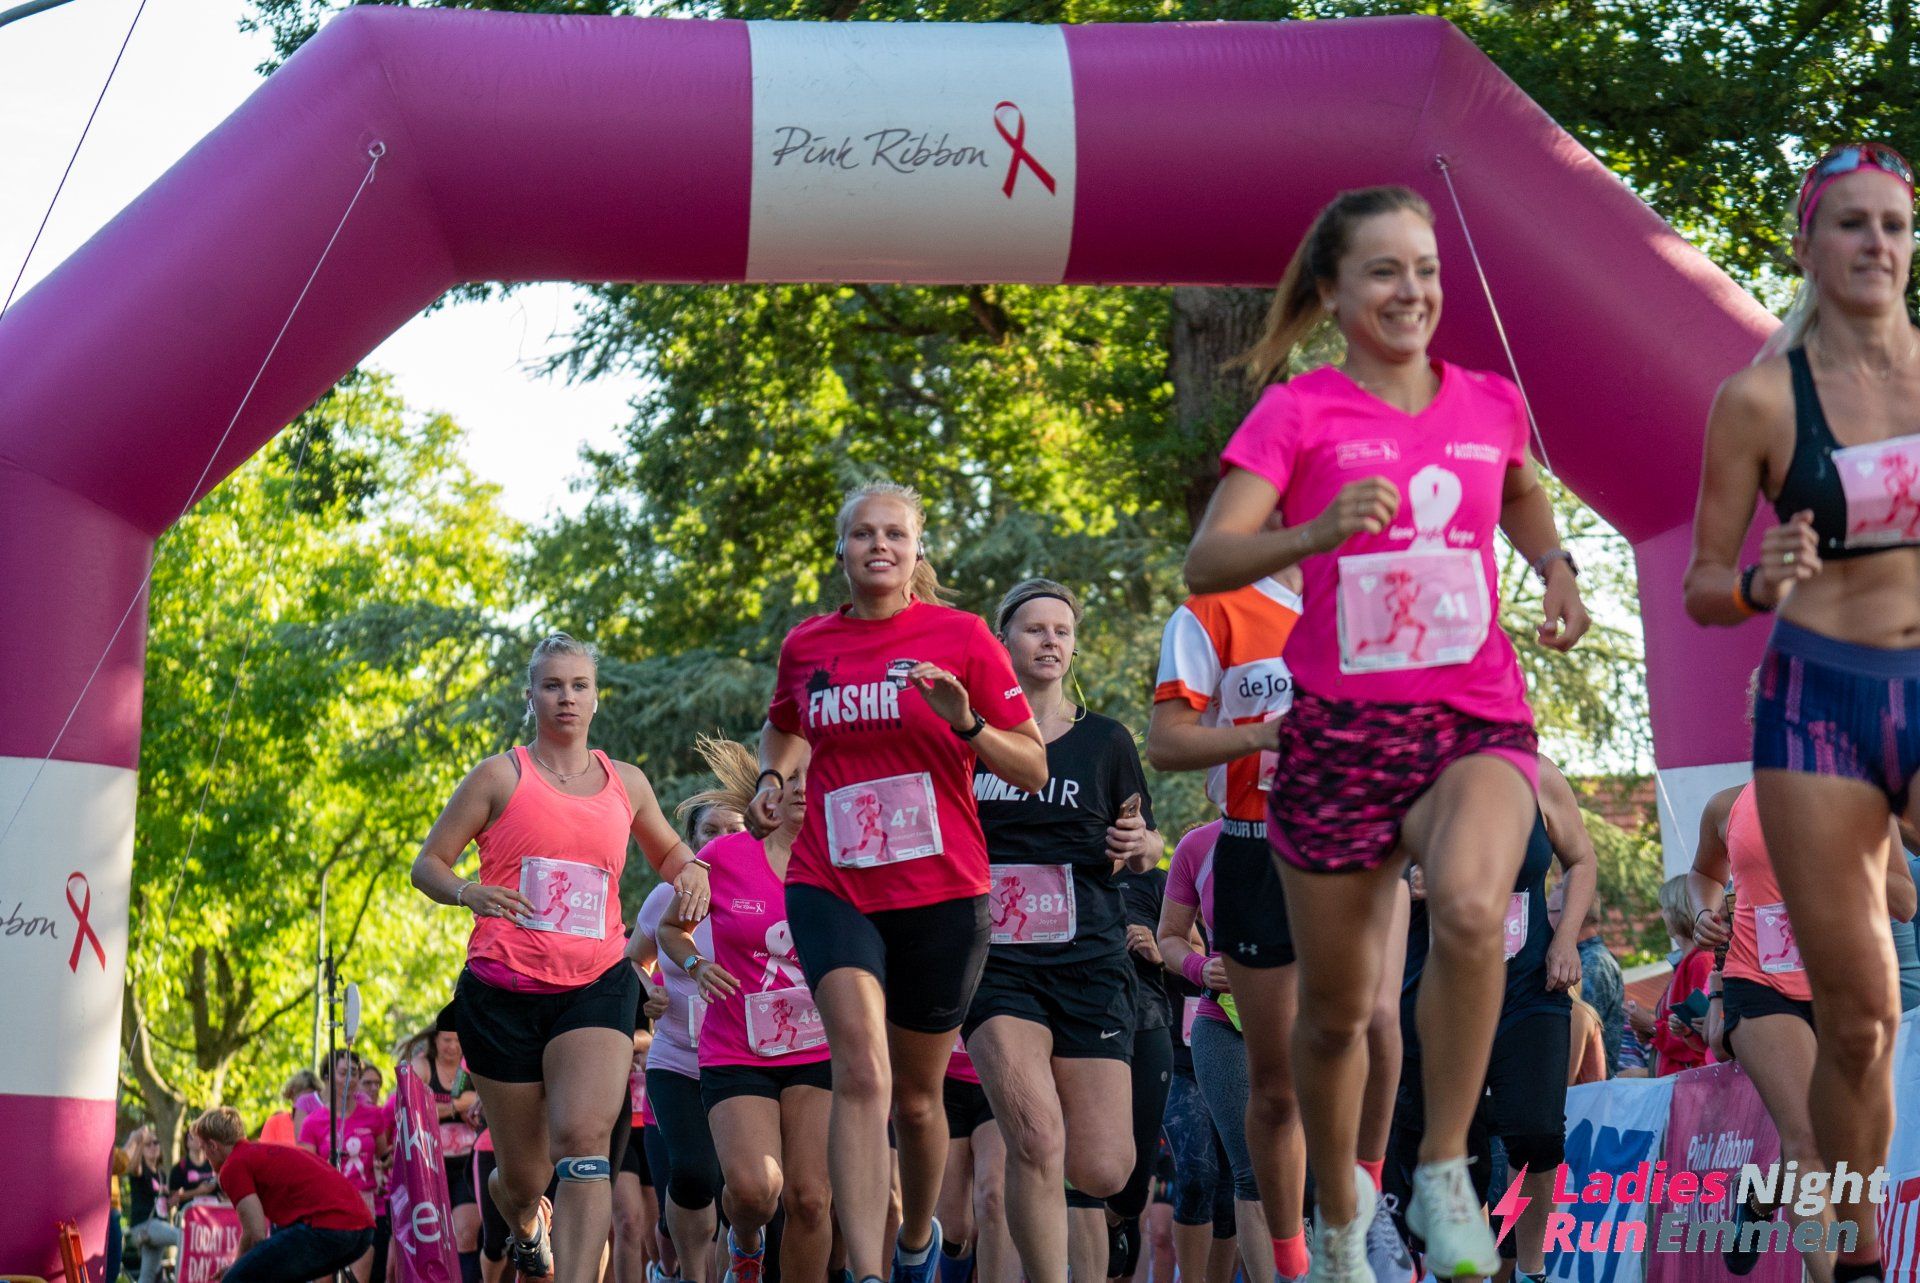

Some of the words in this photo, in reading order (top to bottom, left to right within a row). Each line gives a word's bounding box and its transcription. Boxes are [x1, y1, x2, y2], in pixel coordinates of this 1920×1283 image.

[773, 126, 860, 170] Pink
[864, 128, 989, 173] Ribbon
[1433, 591, 1469, 620] 41
[808, 681, 901, 729] FNSHR
[890, 806, 919, 828] 47
[570, 891, 599, 911] 621
[1025, 893, 1065, 913] 387
[0, 901, 58, 939] bon
[1686, 1133, 1714, 1171] Pink
[1711, 1130, 1754, 1170] Ribbon
[189, 1221, 223, 1254] TODAY
[226, 1226, 238, 1254] IS
[188, 1256, 212, 1283] DAY
